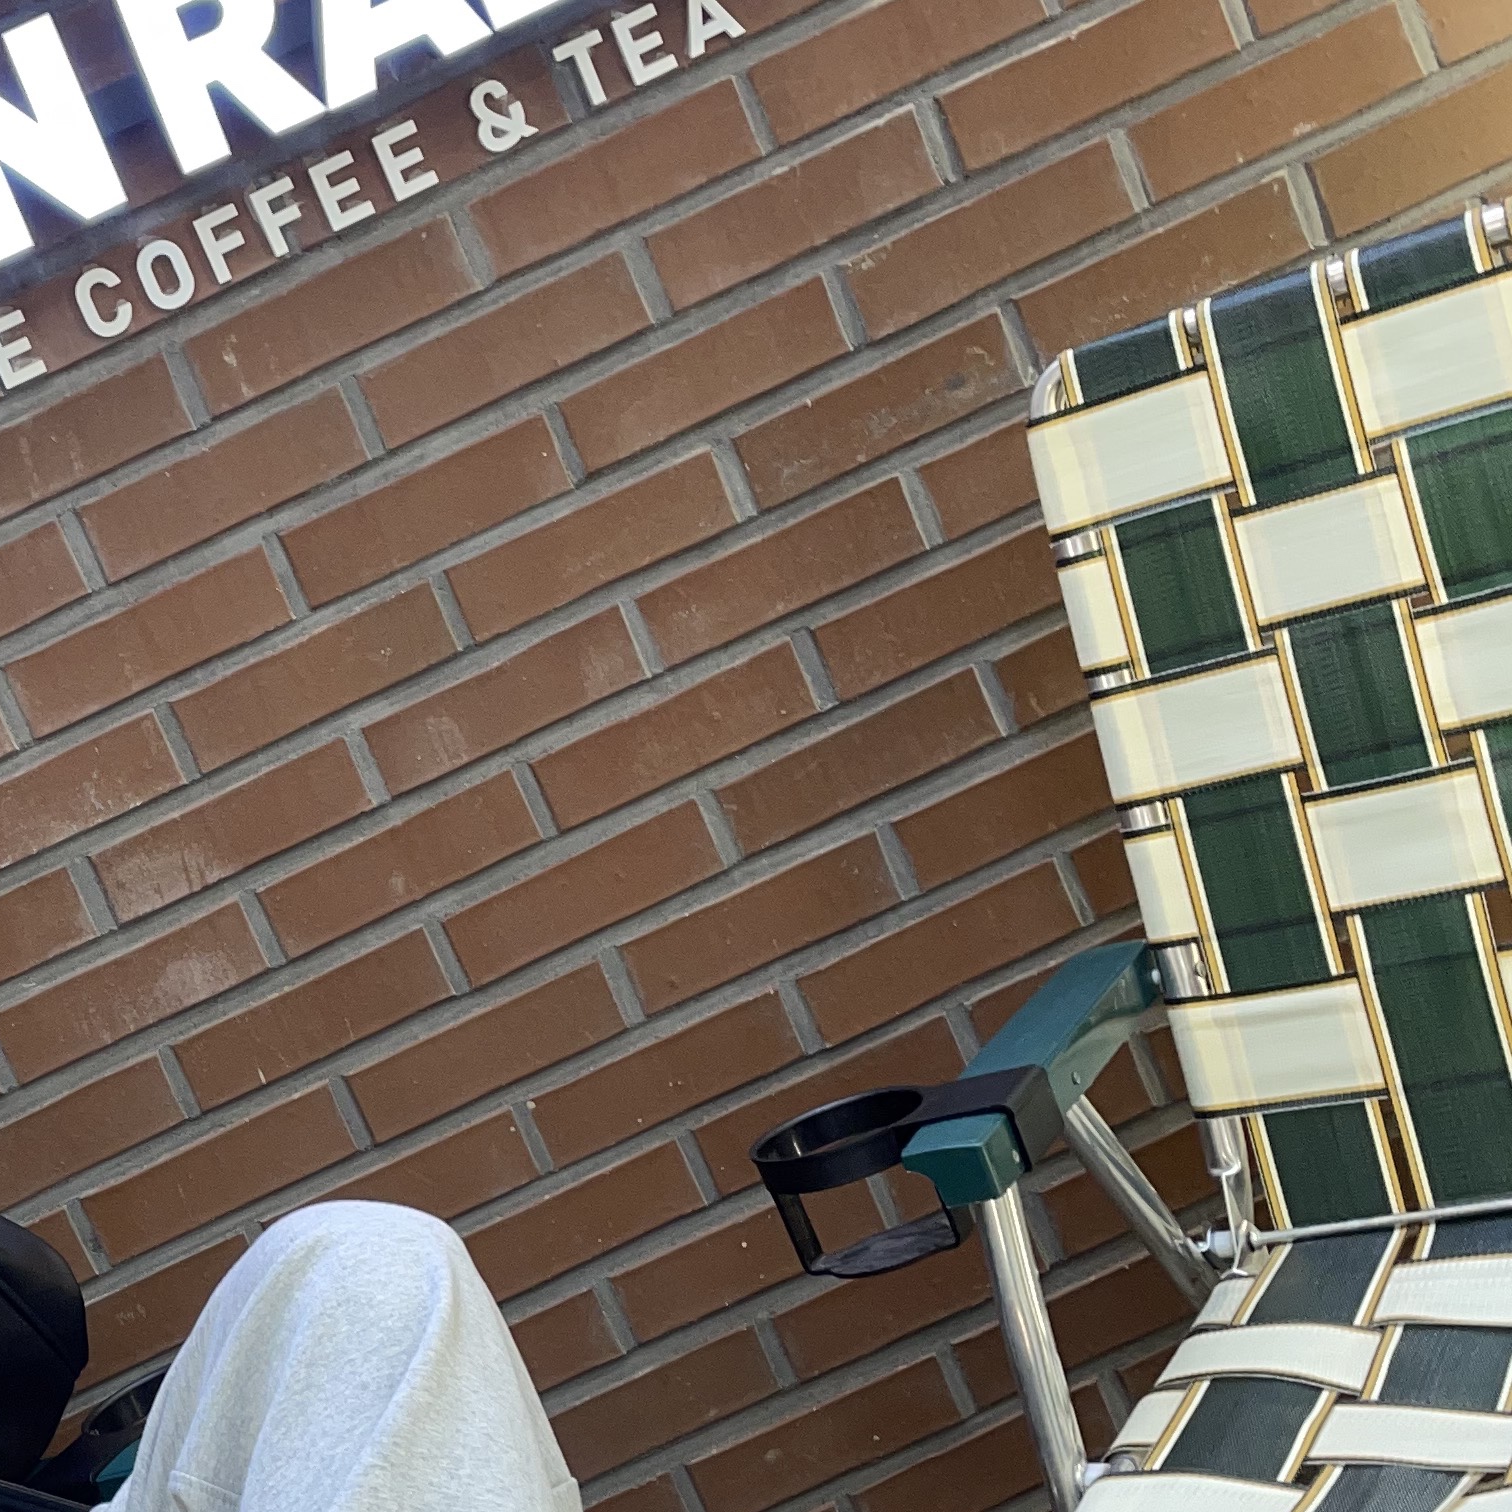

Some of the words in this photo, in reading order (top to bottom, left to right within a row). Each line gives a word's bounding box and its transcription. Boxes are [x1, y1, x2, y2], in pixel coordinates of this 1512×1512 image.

[75, 120, 439, 337] COFFEE
[471, 81, 538, 151] &
[553, 0, 746, 105] TEA
